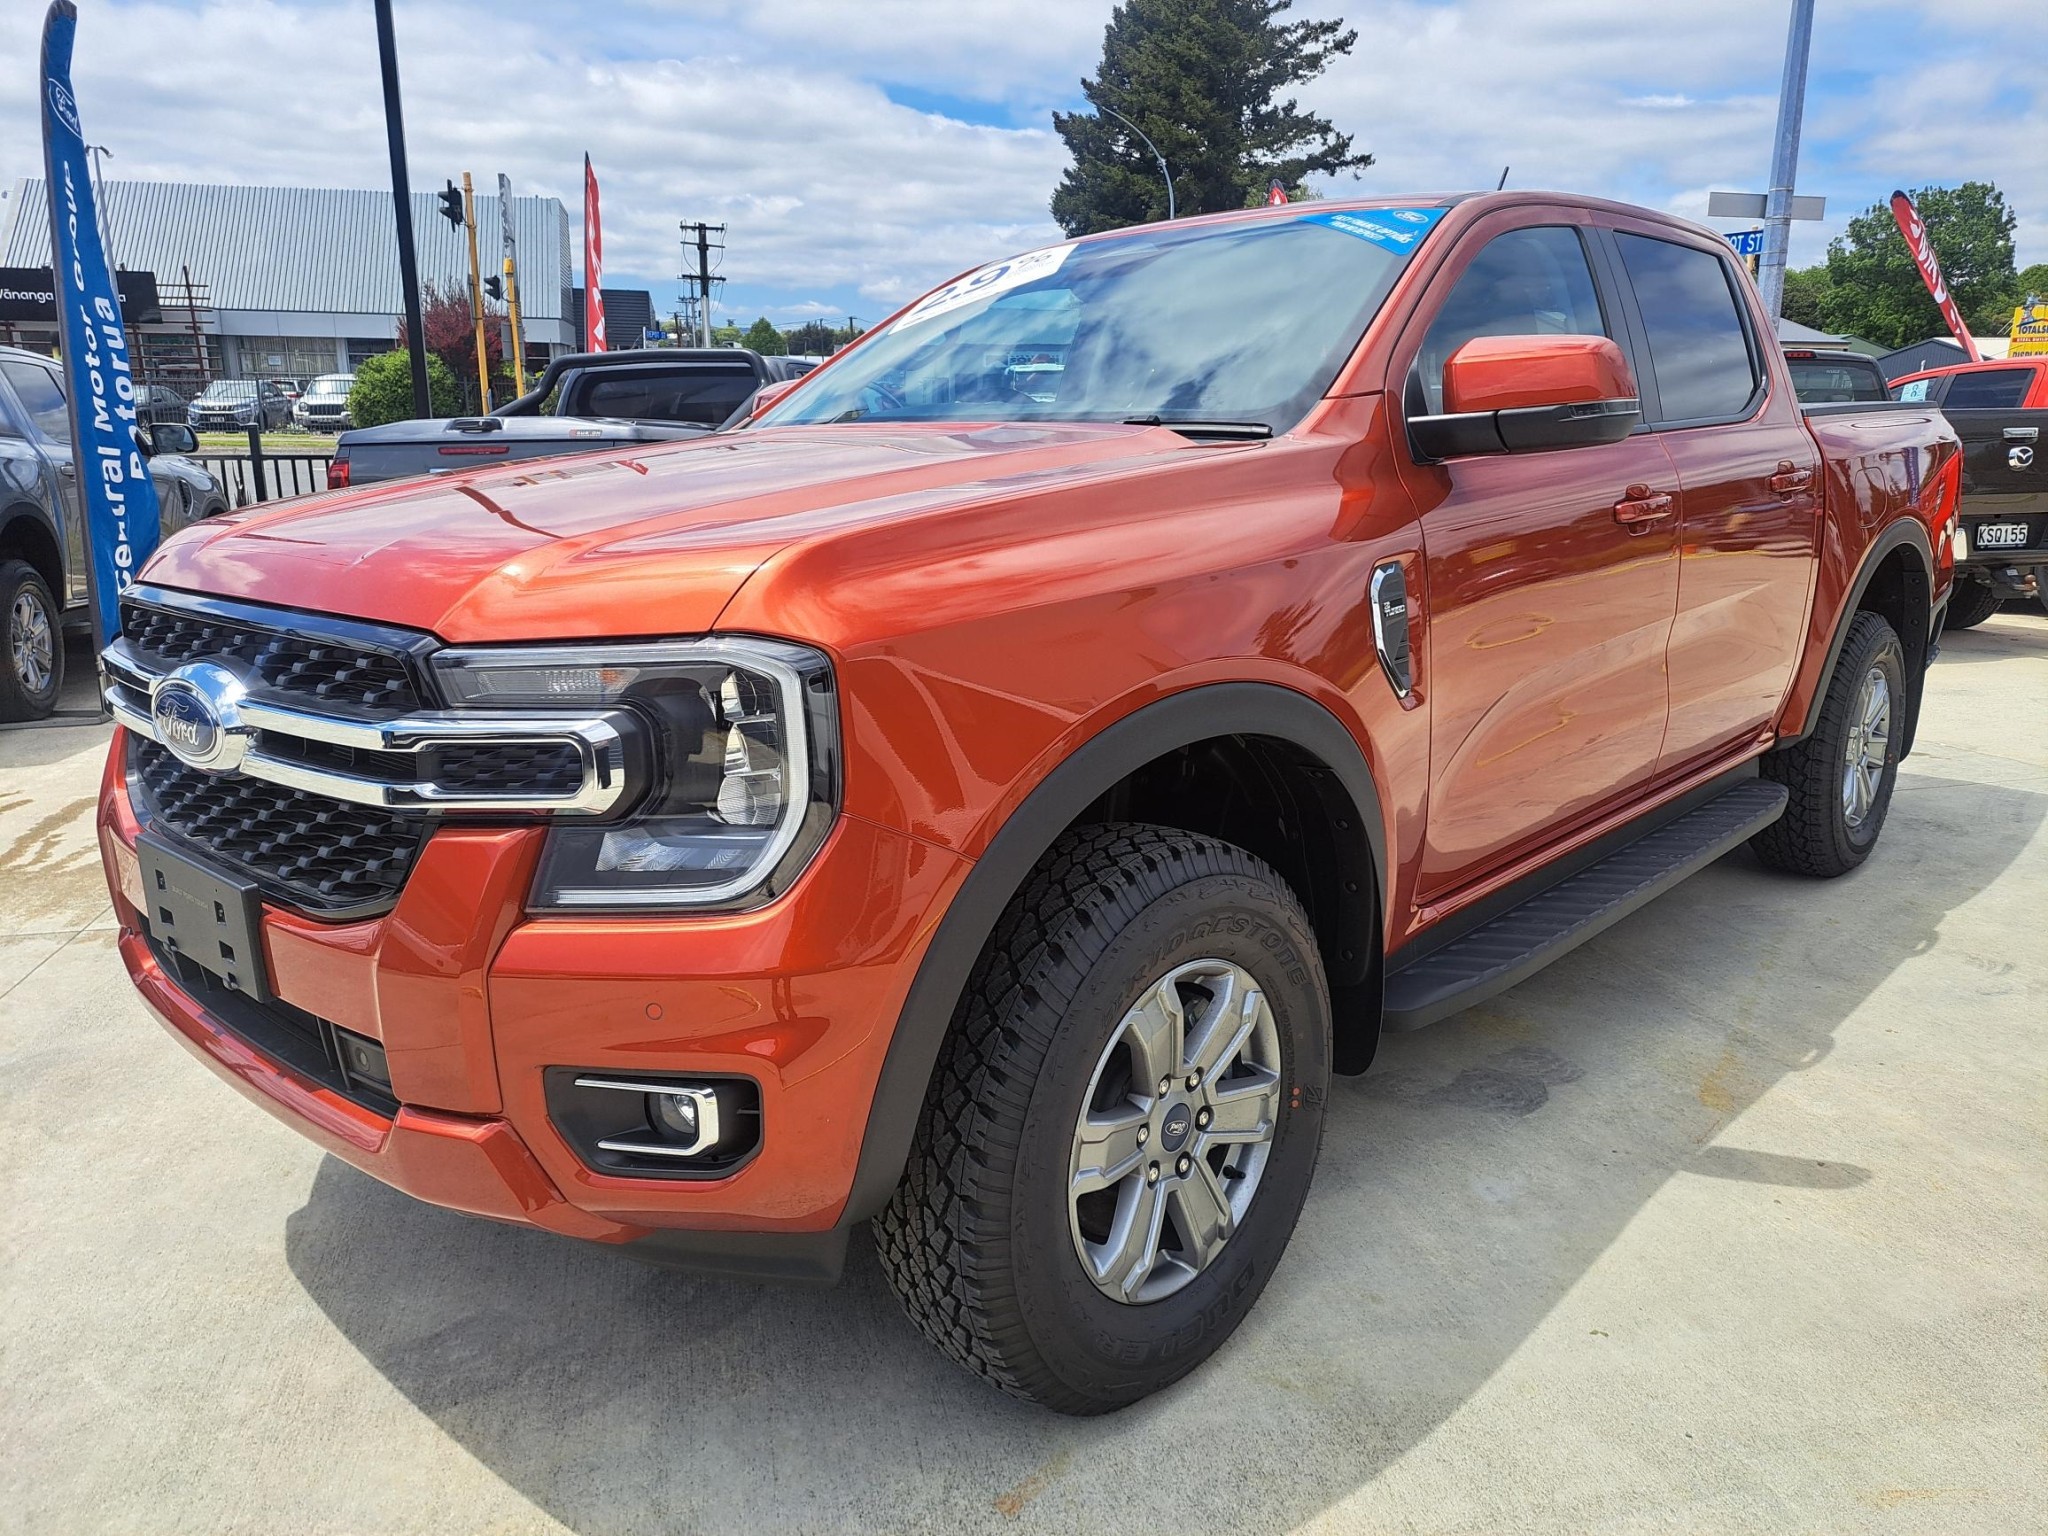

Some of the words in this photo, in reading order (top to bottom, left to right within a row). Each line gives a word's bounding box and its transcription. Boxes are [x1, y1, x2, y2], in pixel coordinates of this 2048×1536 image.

[1746, 233, 1763, 252] ST
[0, 288, 54, 304] ānanga
[80, 304, 114, 433] Motor
[1978, 527, 2027, 544] KSQ155
[157, 692, 200, 746] Ford
